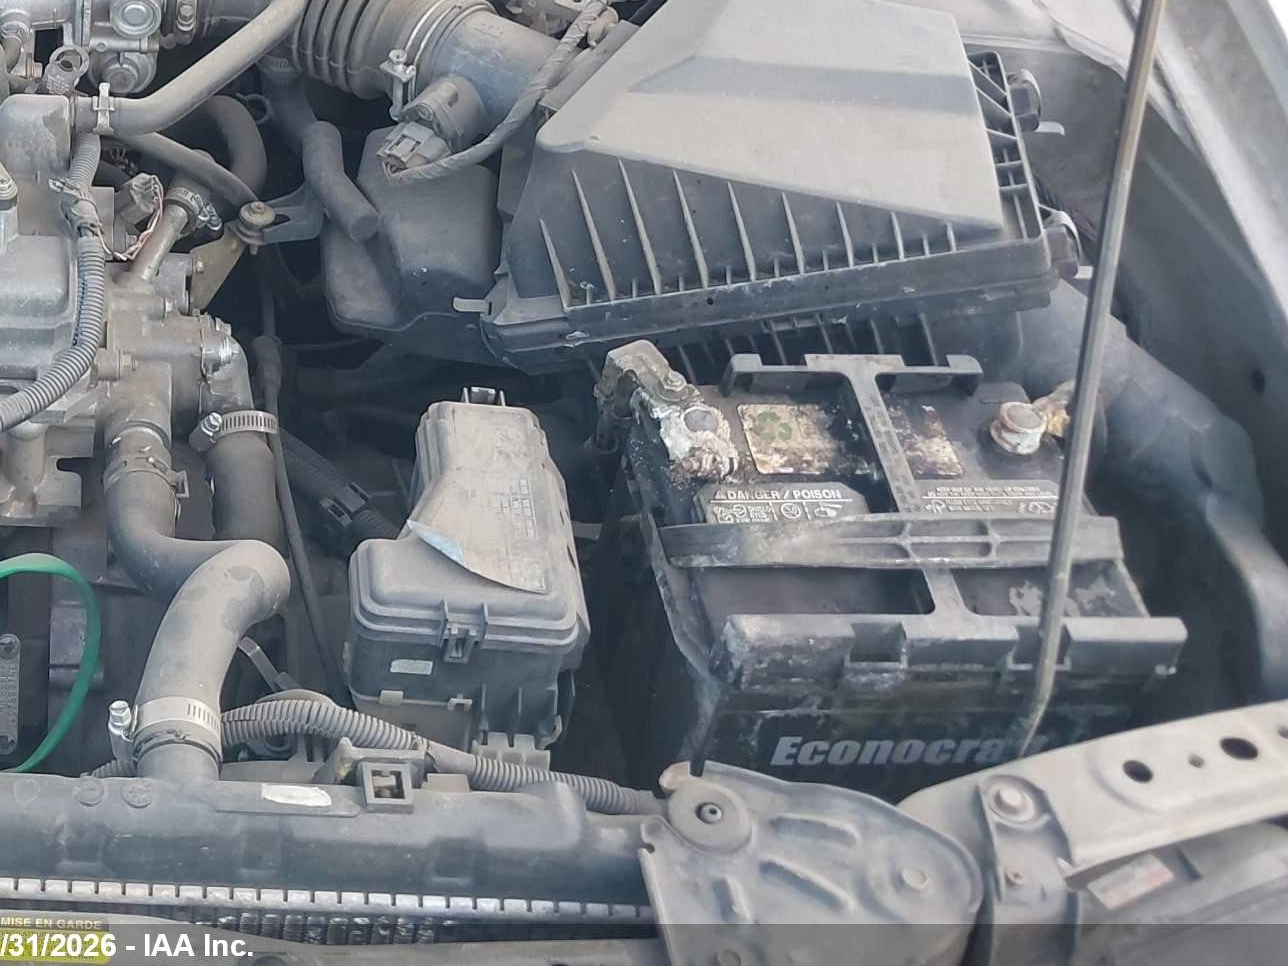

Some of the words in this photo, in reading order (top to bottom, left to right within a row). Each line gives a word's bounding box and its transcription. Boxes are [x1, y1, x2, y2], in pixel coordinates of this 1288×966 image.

[727, 489, 781, 500] DANGER
[792, 489, 843, 500] POISON
[770, 735, 1049, 766] Econocra
[0, 916, 31, 927] MISE
[35, 917, 53, 928] EN
[56, 918, 102, 930] GARDE
